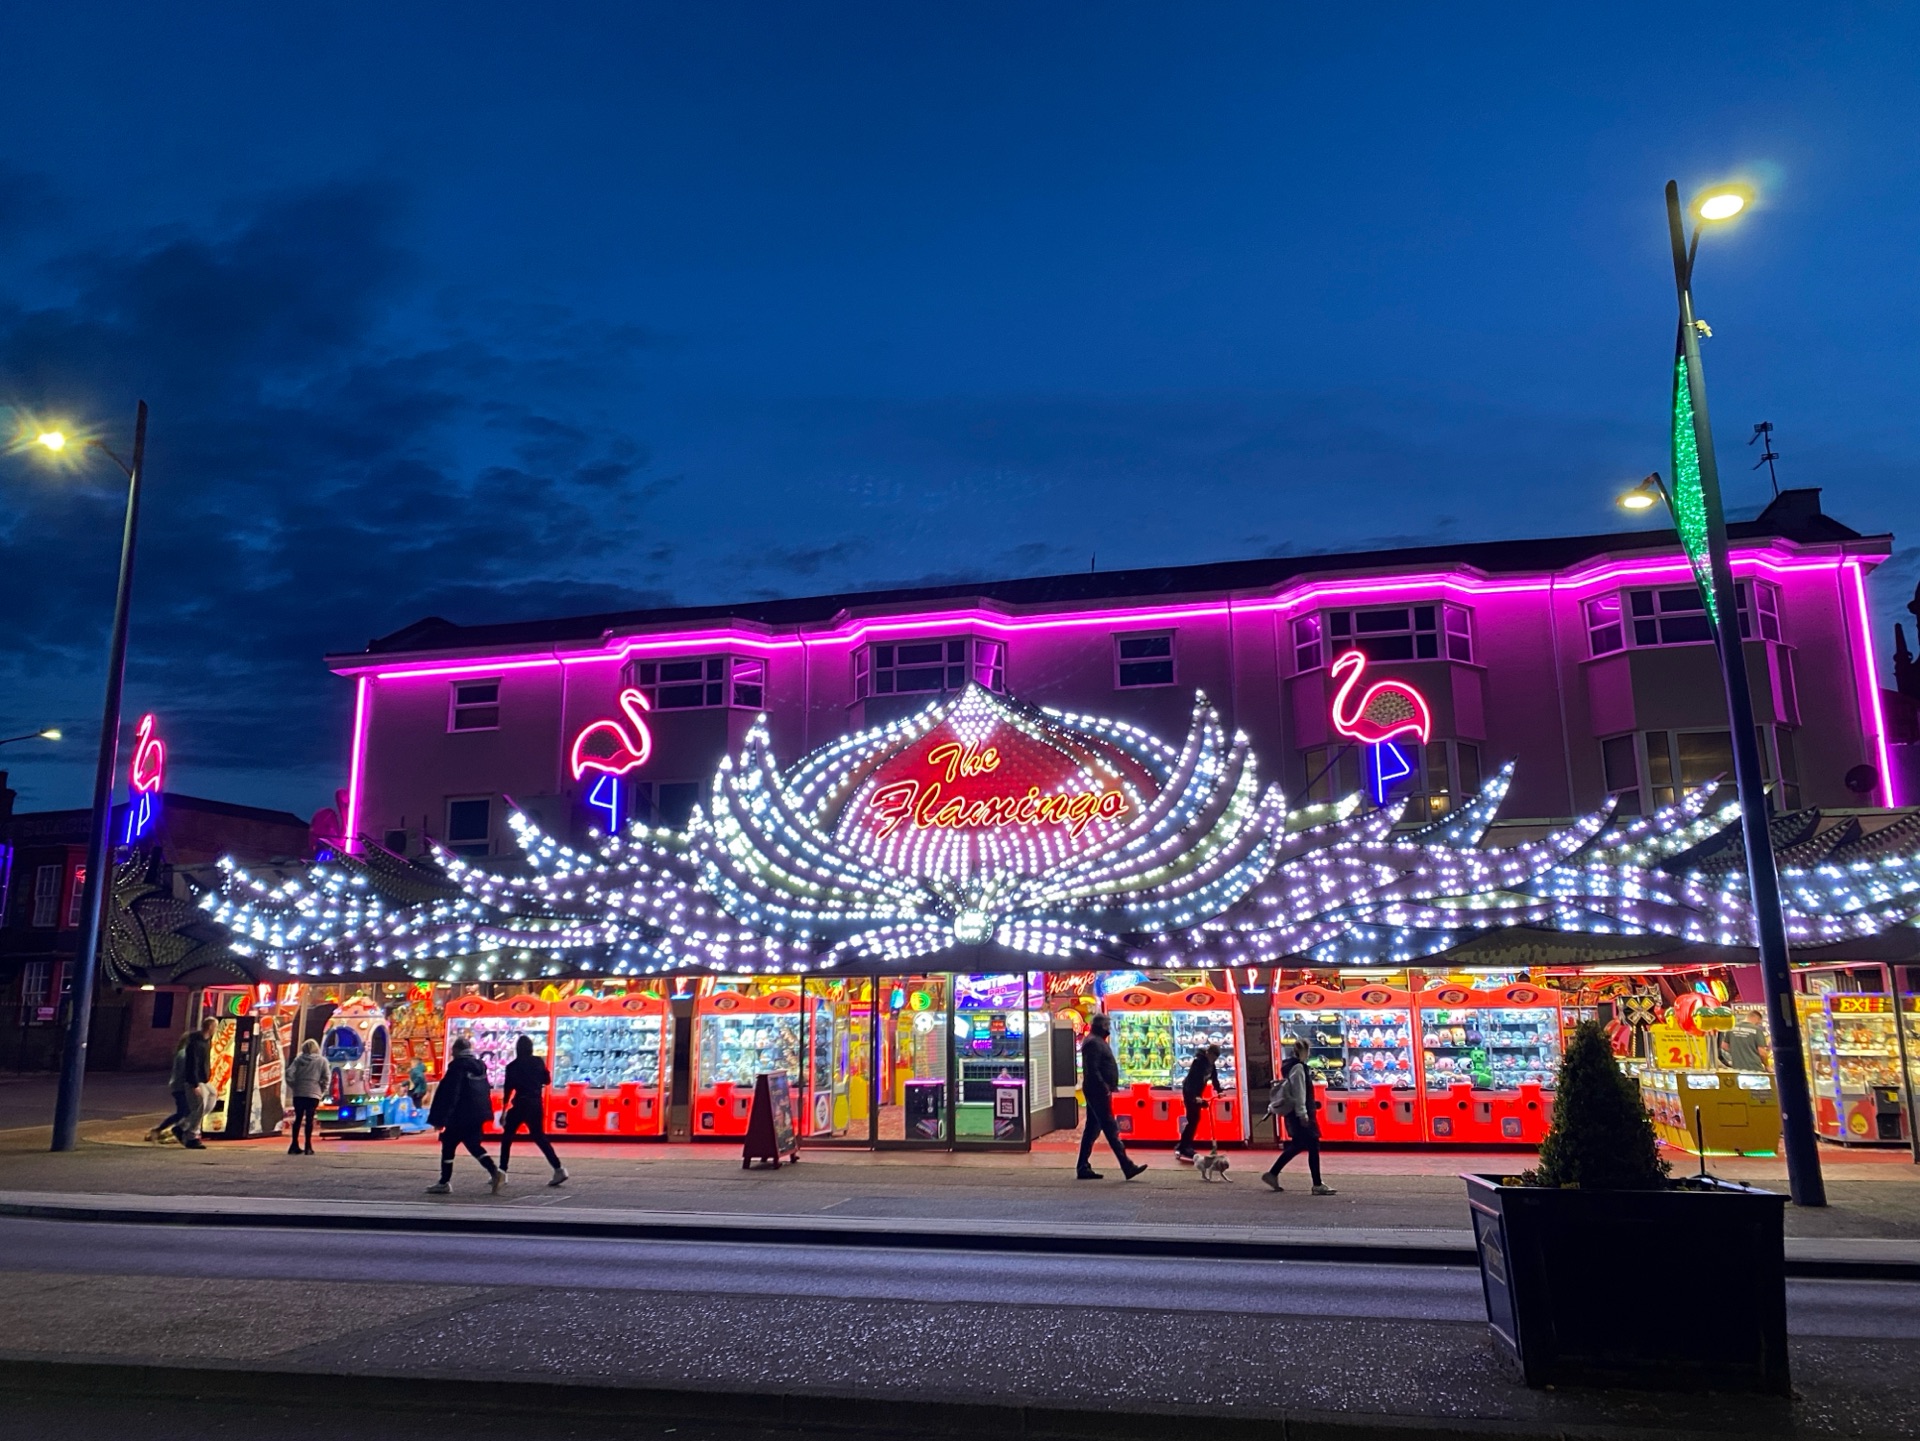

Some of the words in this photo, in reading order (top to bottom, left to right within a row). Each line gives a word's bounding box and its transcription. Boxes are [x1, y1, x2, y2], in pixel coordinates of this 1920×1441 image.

[928, 739, 1000, 782] The
[870, 780, 1129, 839] Flamingo
[215, 1023, 236, 1054] Coke
